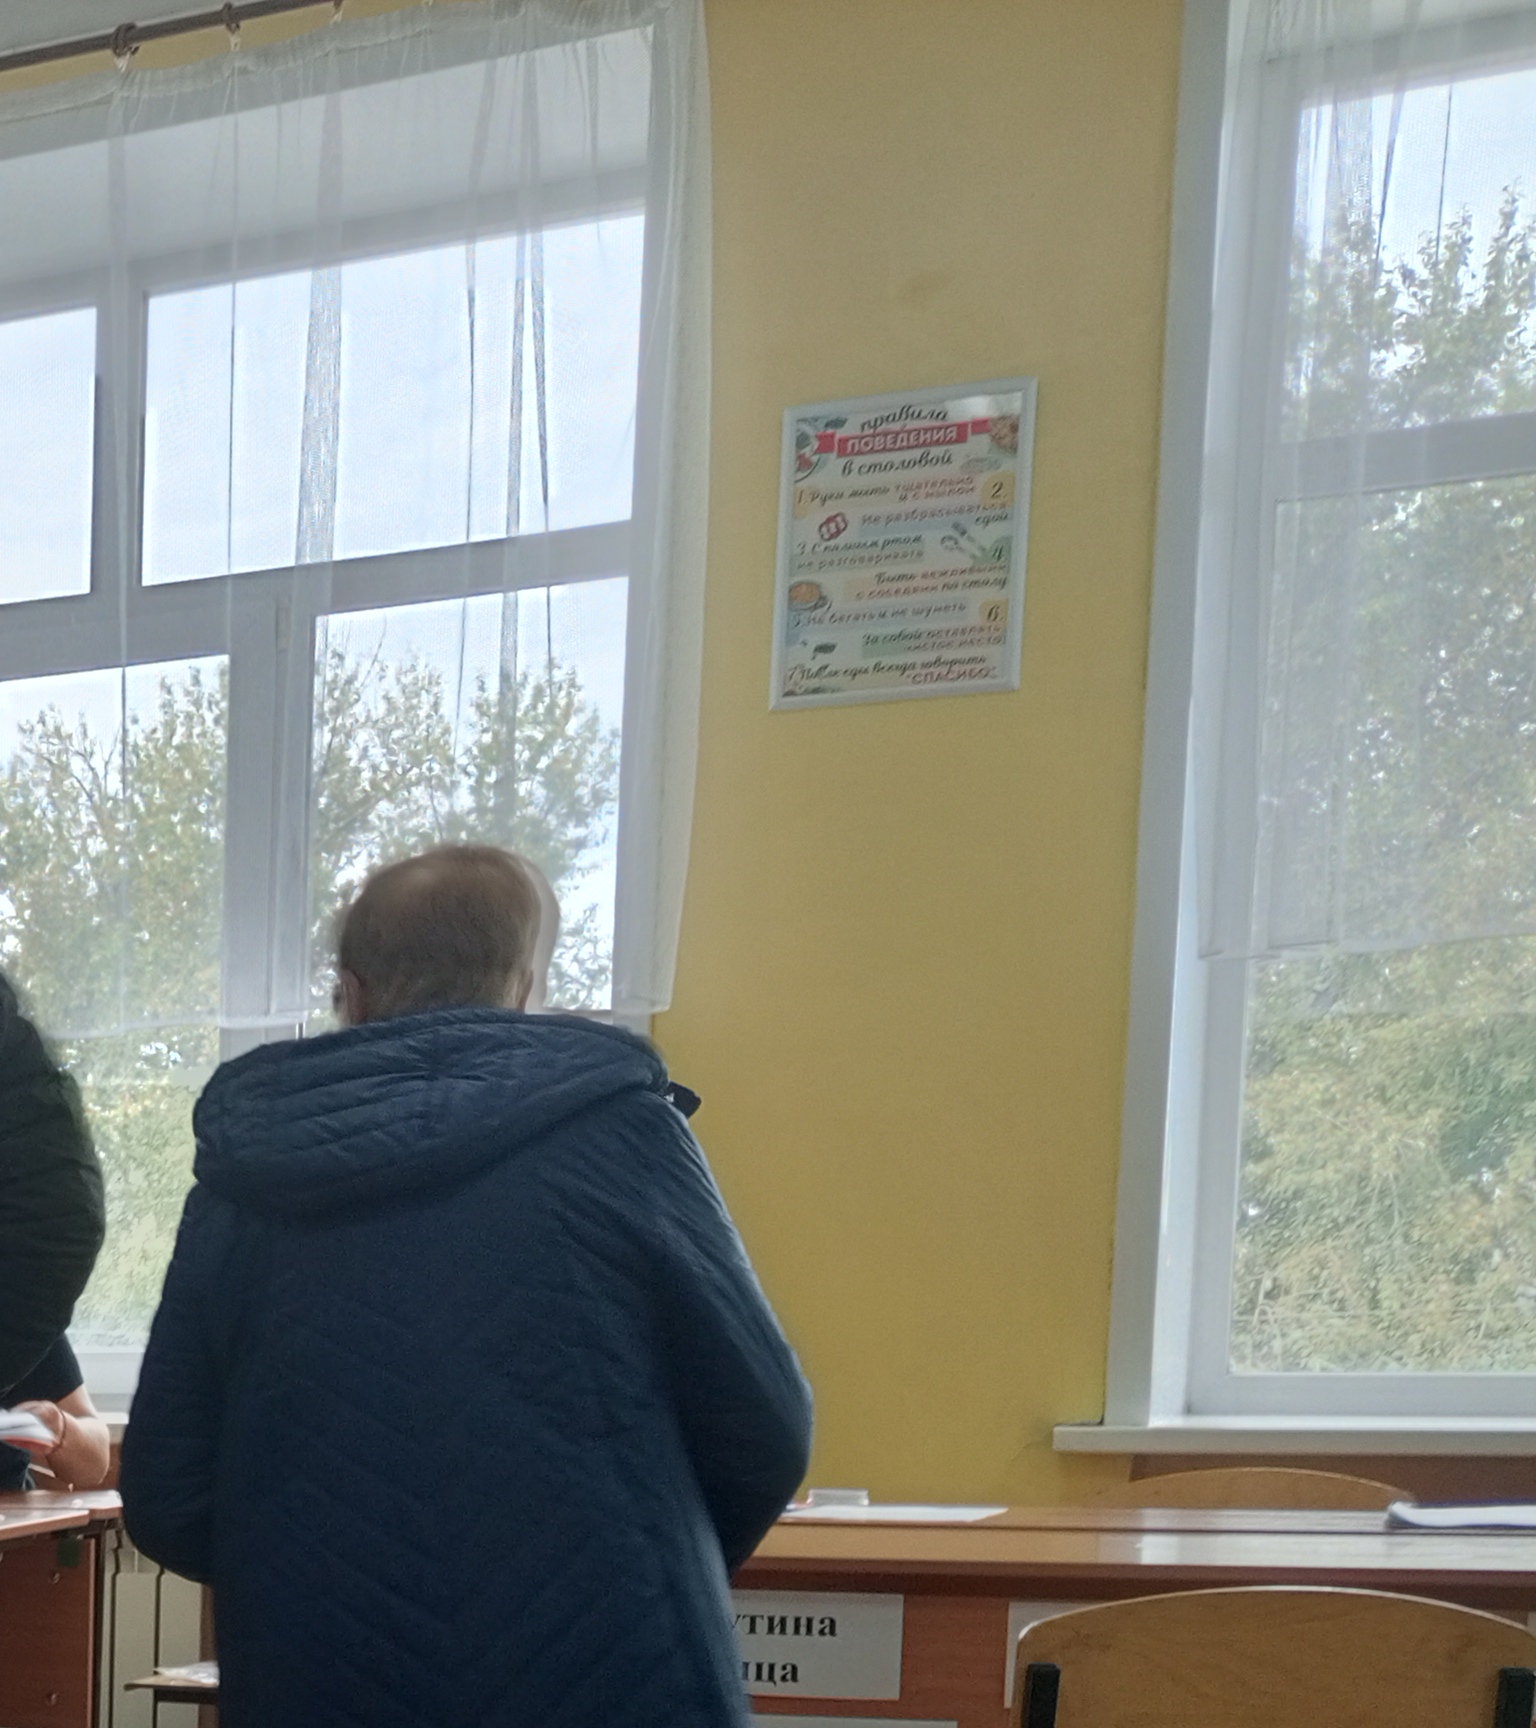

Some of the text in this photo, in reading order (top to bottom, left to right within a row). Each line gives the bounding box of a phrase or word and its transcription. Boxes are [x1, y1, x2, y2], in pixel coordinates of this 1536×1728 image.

[860, 404, 949, 434] правила
[846, 425, 959, 454] ПОВЕДЕНИЯ
[841, 450, 953, 478] в столовой
